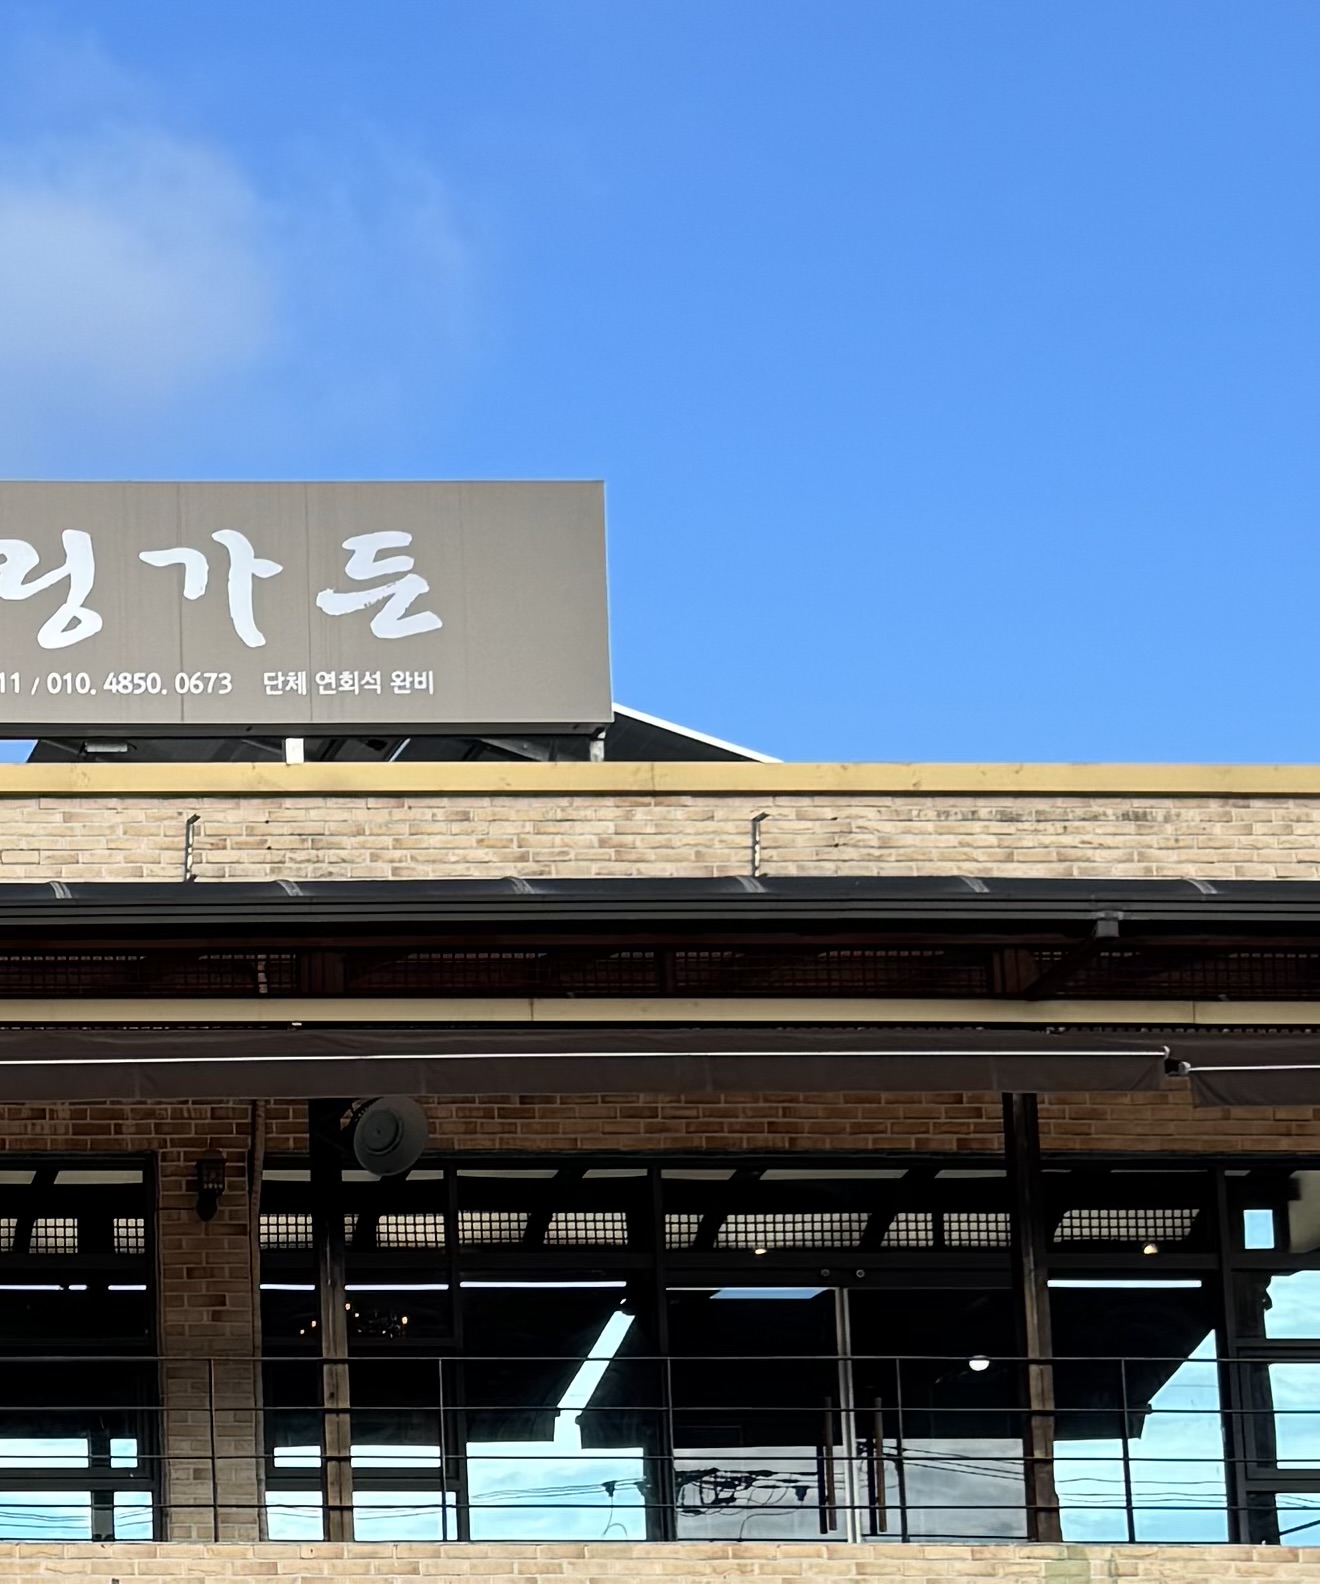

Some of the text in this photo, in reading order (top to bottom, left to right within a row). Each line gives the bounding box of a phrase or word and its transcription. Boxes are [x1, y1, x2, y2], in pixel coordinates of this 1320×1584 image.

[263, 670, 307, 695] 단체
[315, 670, 381, 695] 연회석
[390, 670, 434, 695] 완비
